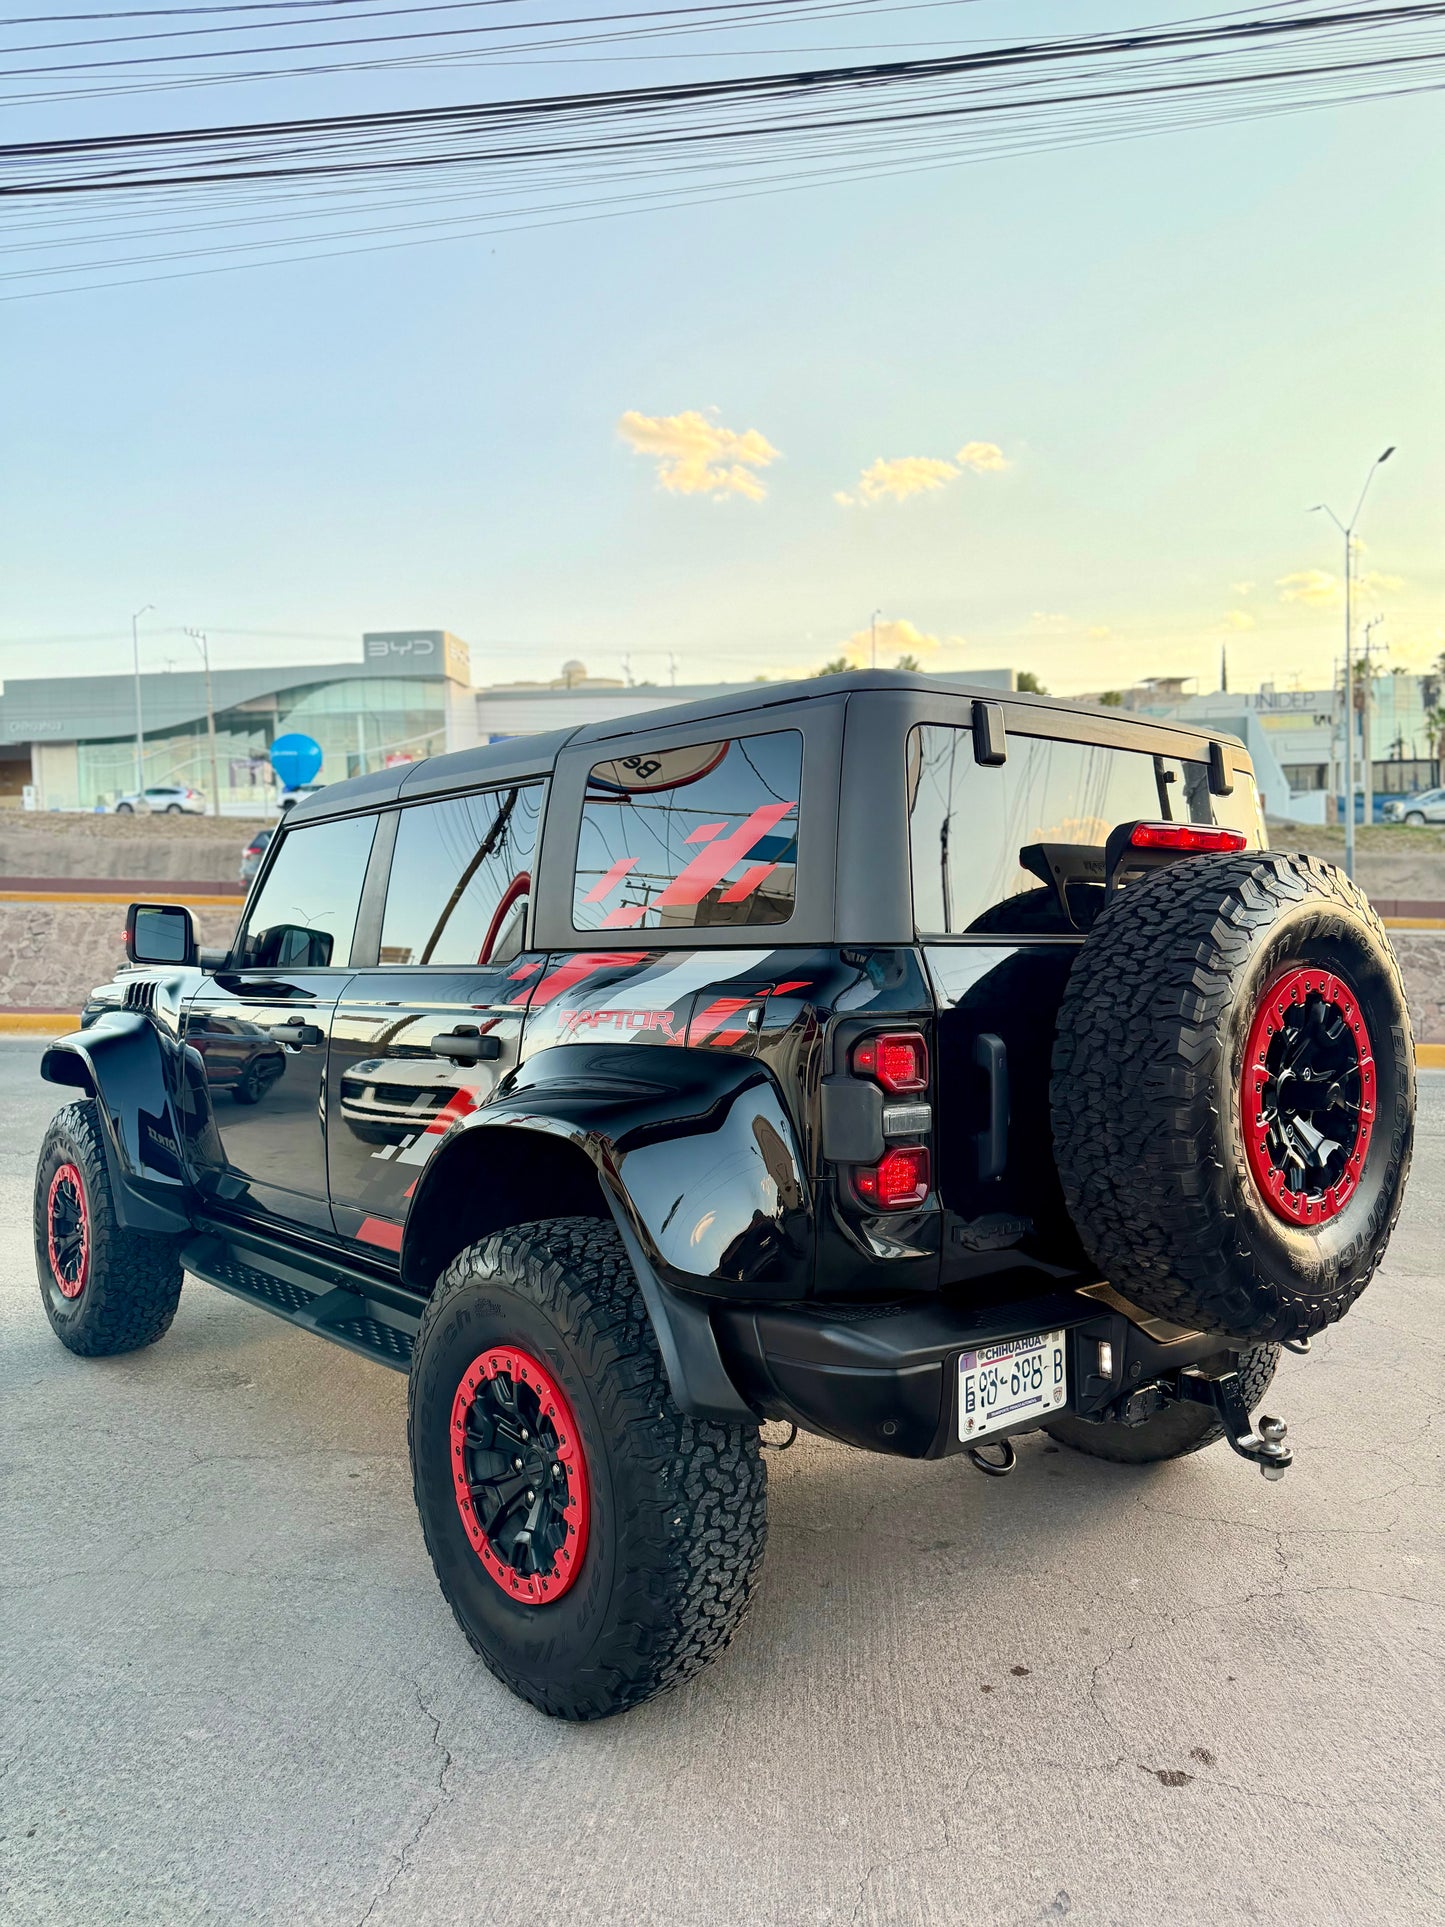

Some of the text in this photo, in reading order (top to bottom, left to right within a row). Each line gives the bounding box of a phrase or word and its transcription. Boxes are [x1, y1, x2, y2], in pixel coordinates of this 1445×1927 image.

[368, 639, 434, 657] BYD
[1244, 690, 1316, 709] UNIDEP
[557, 1009, 678, 1042] RAPTOR
[1323, 1026, 1410, 1284] BFGoodrich
[985, 1335, 1042, 1360] CHIHUAHUA
